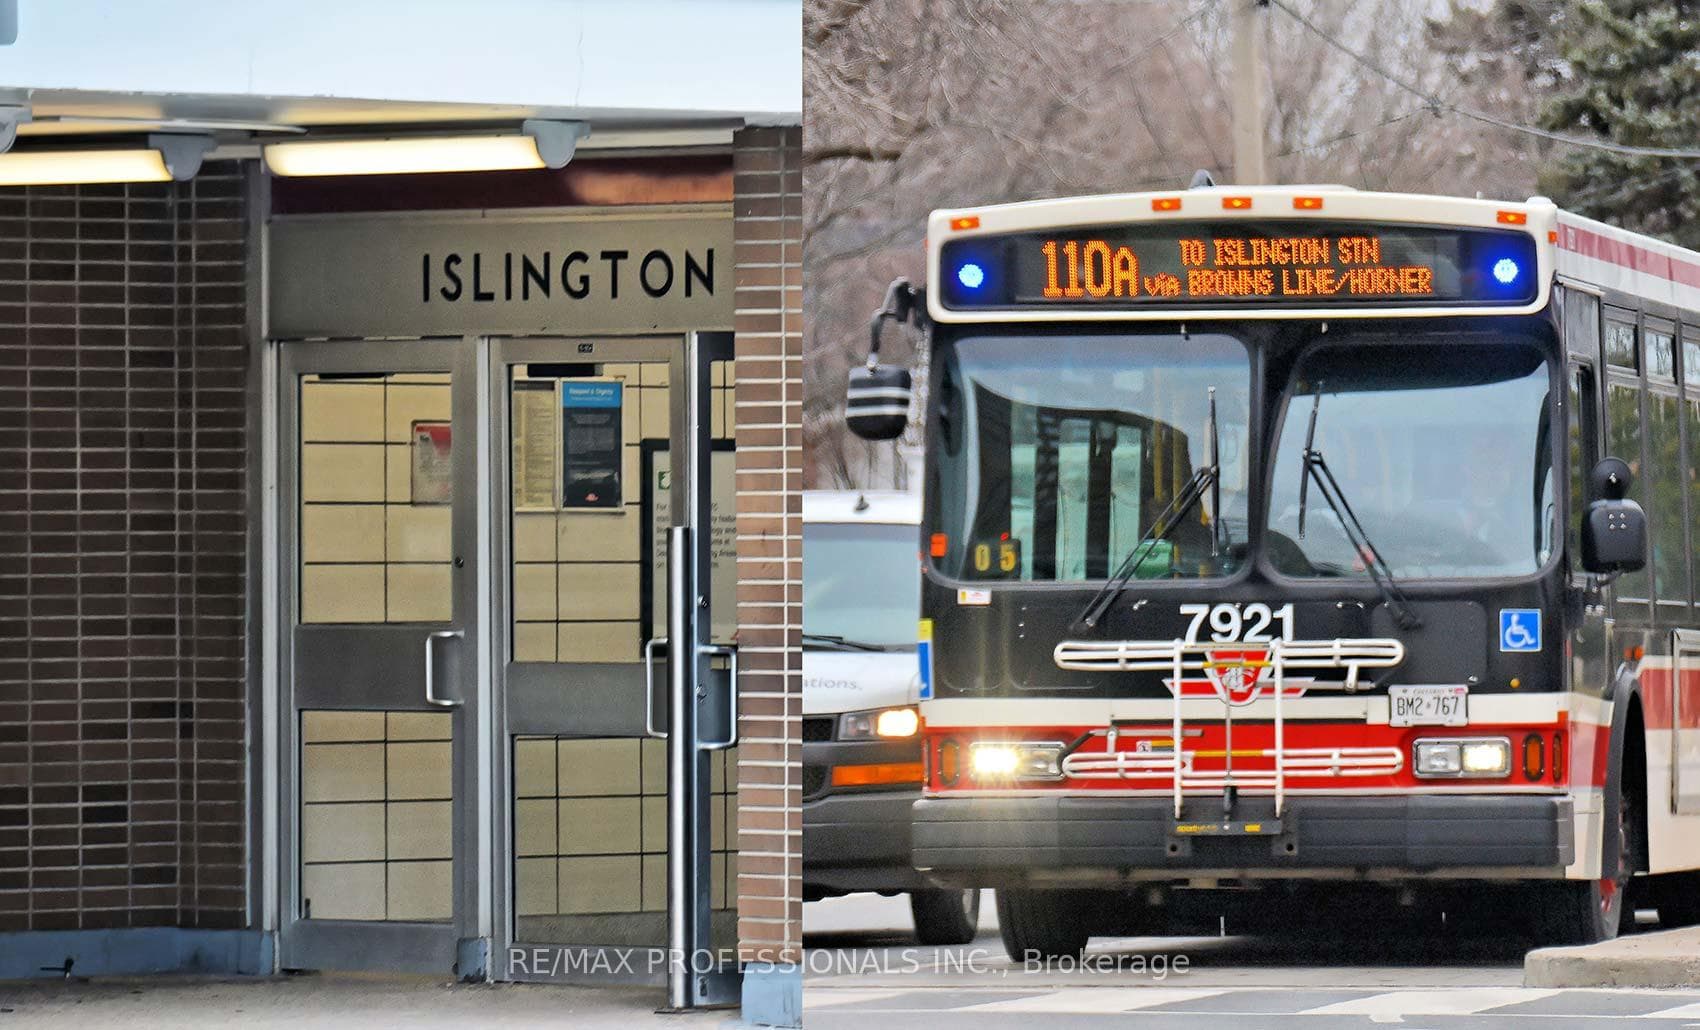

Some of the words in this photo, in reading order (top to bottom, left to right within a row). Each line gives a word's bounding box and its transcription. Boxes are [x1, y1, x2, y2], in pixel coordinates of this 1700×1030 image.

[1042, 240, 1139, 297] 110A
[1179, 239, 1206, 266] TO
[1213, 238, 1330, 266] ISLINGTON
[1338, 237, 1380, 264] STN
[423, 248, 715, 302] ISLINGTON
[1143, 273, 1180, 297] via
[1187, 268, 1275, 296] BROWNS
[1282, 267, 1433, 295] LINE/HORNER
[1179, 602, 1294, 643] 7921
